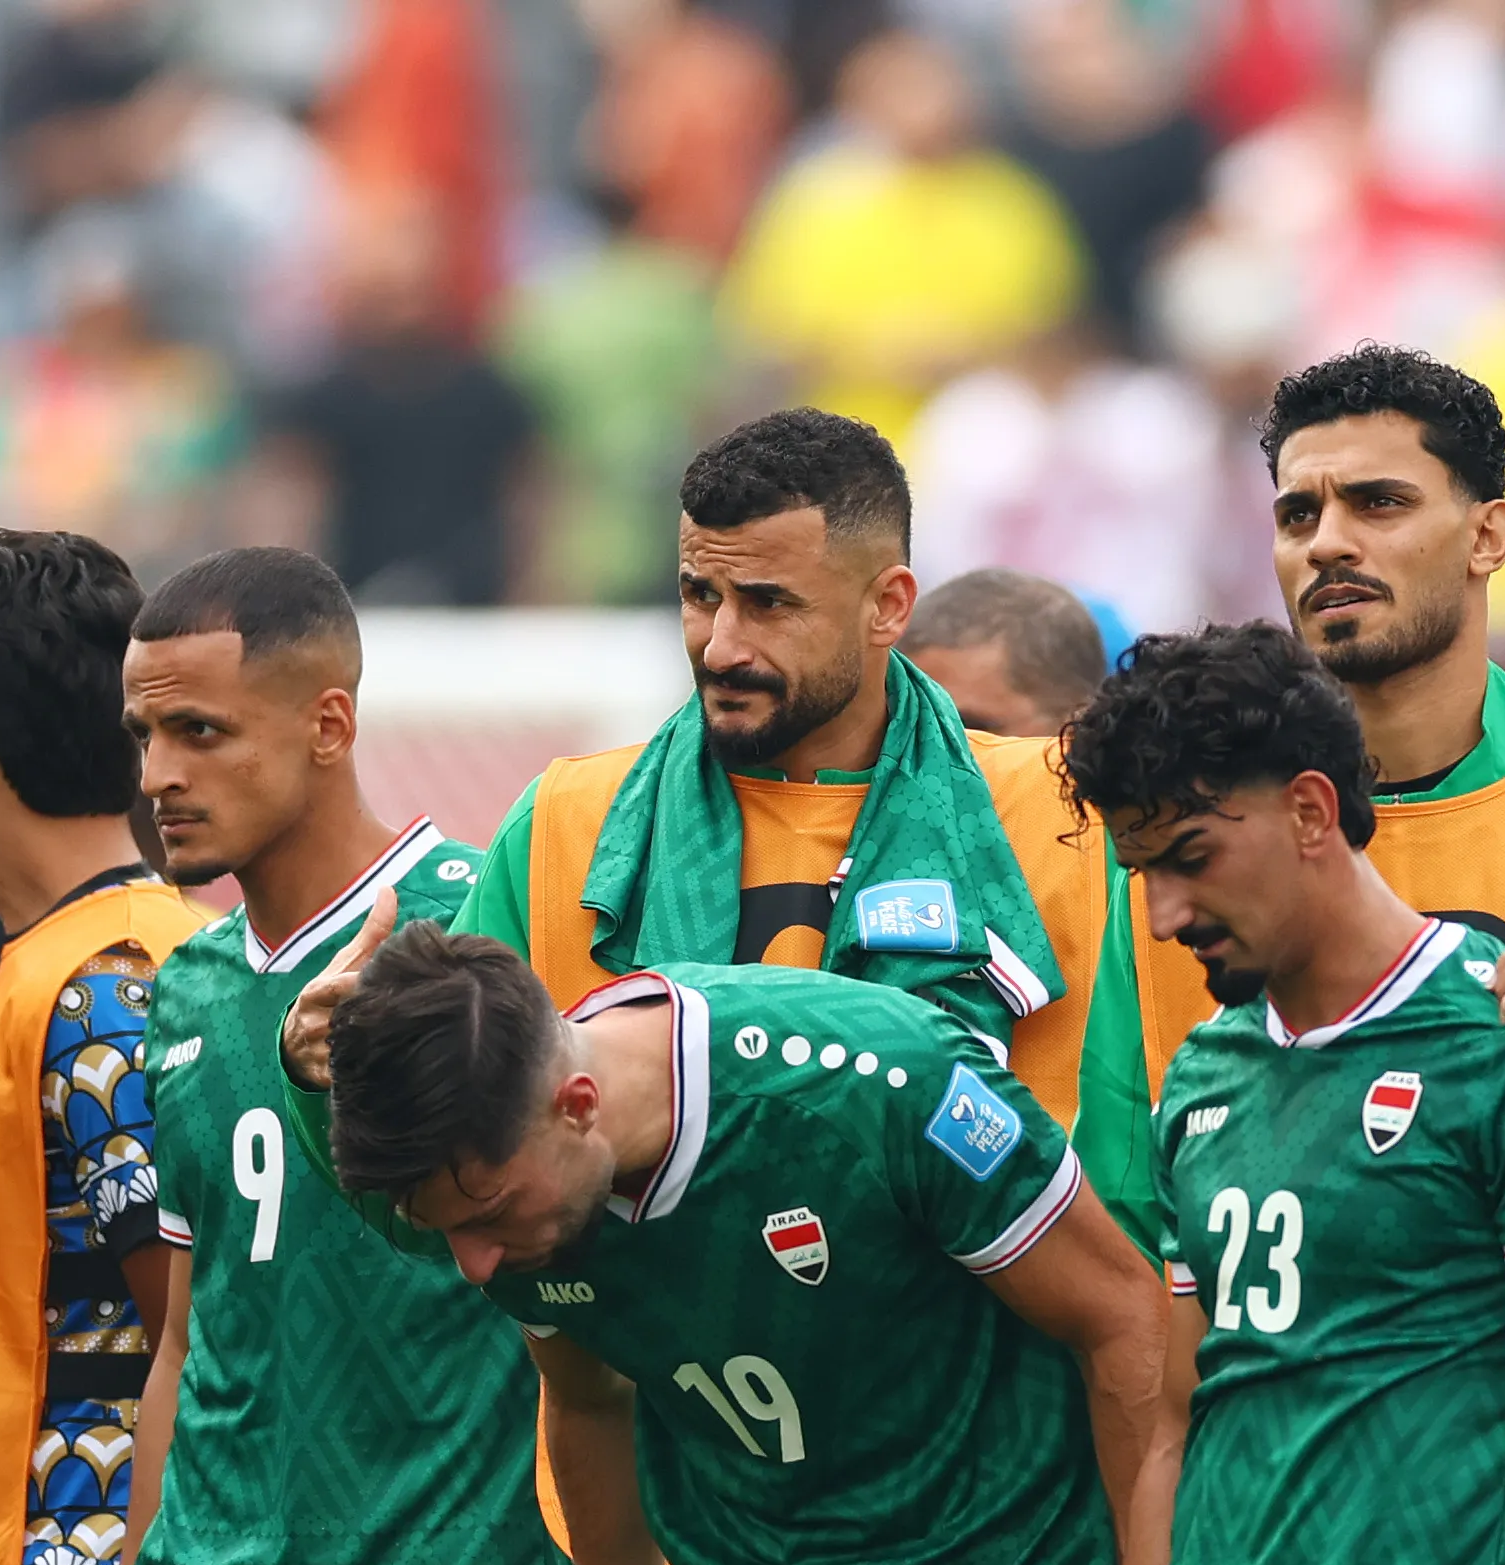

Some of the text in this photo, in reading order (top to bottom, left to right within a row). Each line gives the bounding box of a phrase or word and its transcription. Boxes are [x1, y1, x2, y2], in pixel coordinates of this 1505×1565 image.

[160, 1036, 203, 1072] JAKO
[975, 1112, 1007, 1154] PEACE
[232, 1107, 285, 1263] 9
[771, 1211, 808, 1228] IRAQ
[1207, 1186, 1304, 1334] 23
[536, 1281, 595, 1305] JAKO
[672, 1354, 807, 1464] 19
